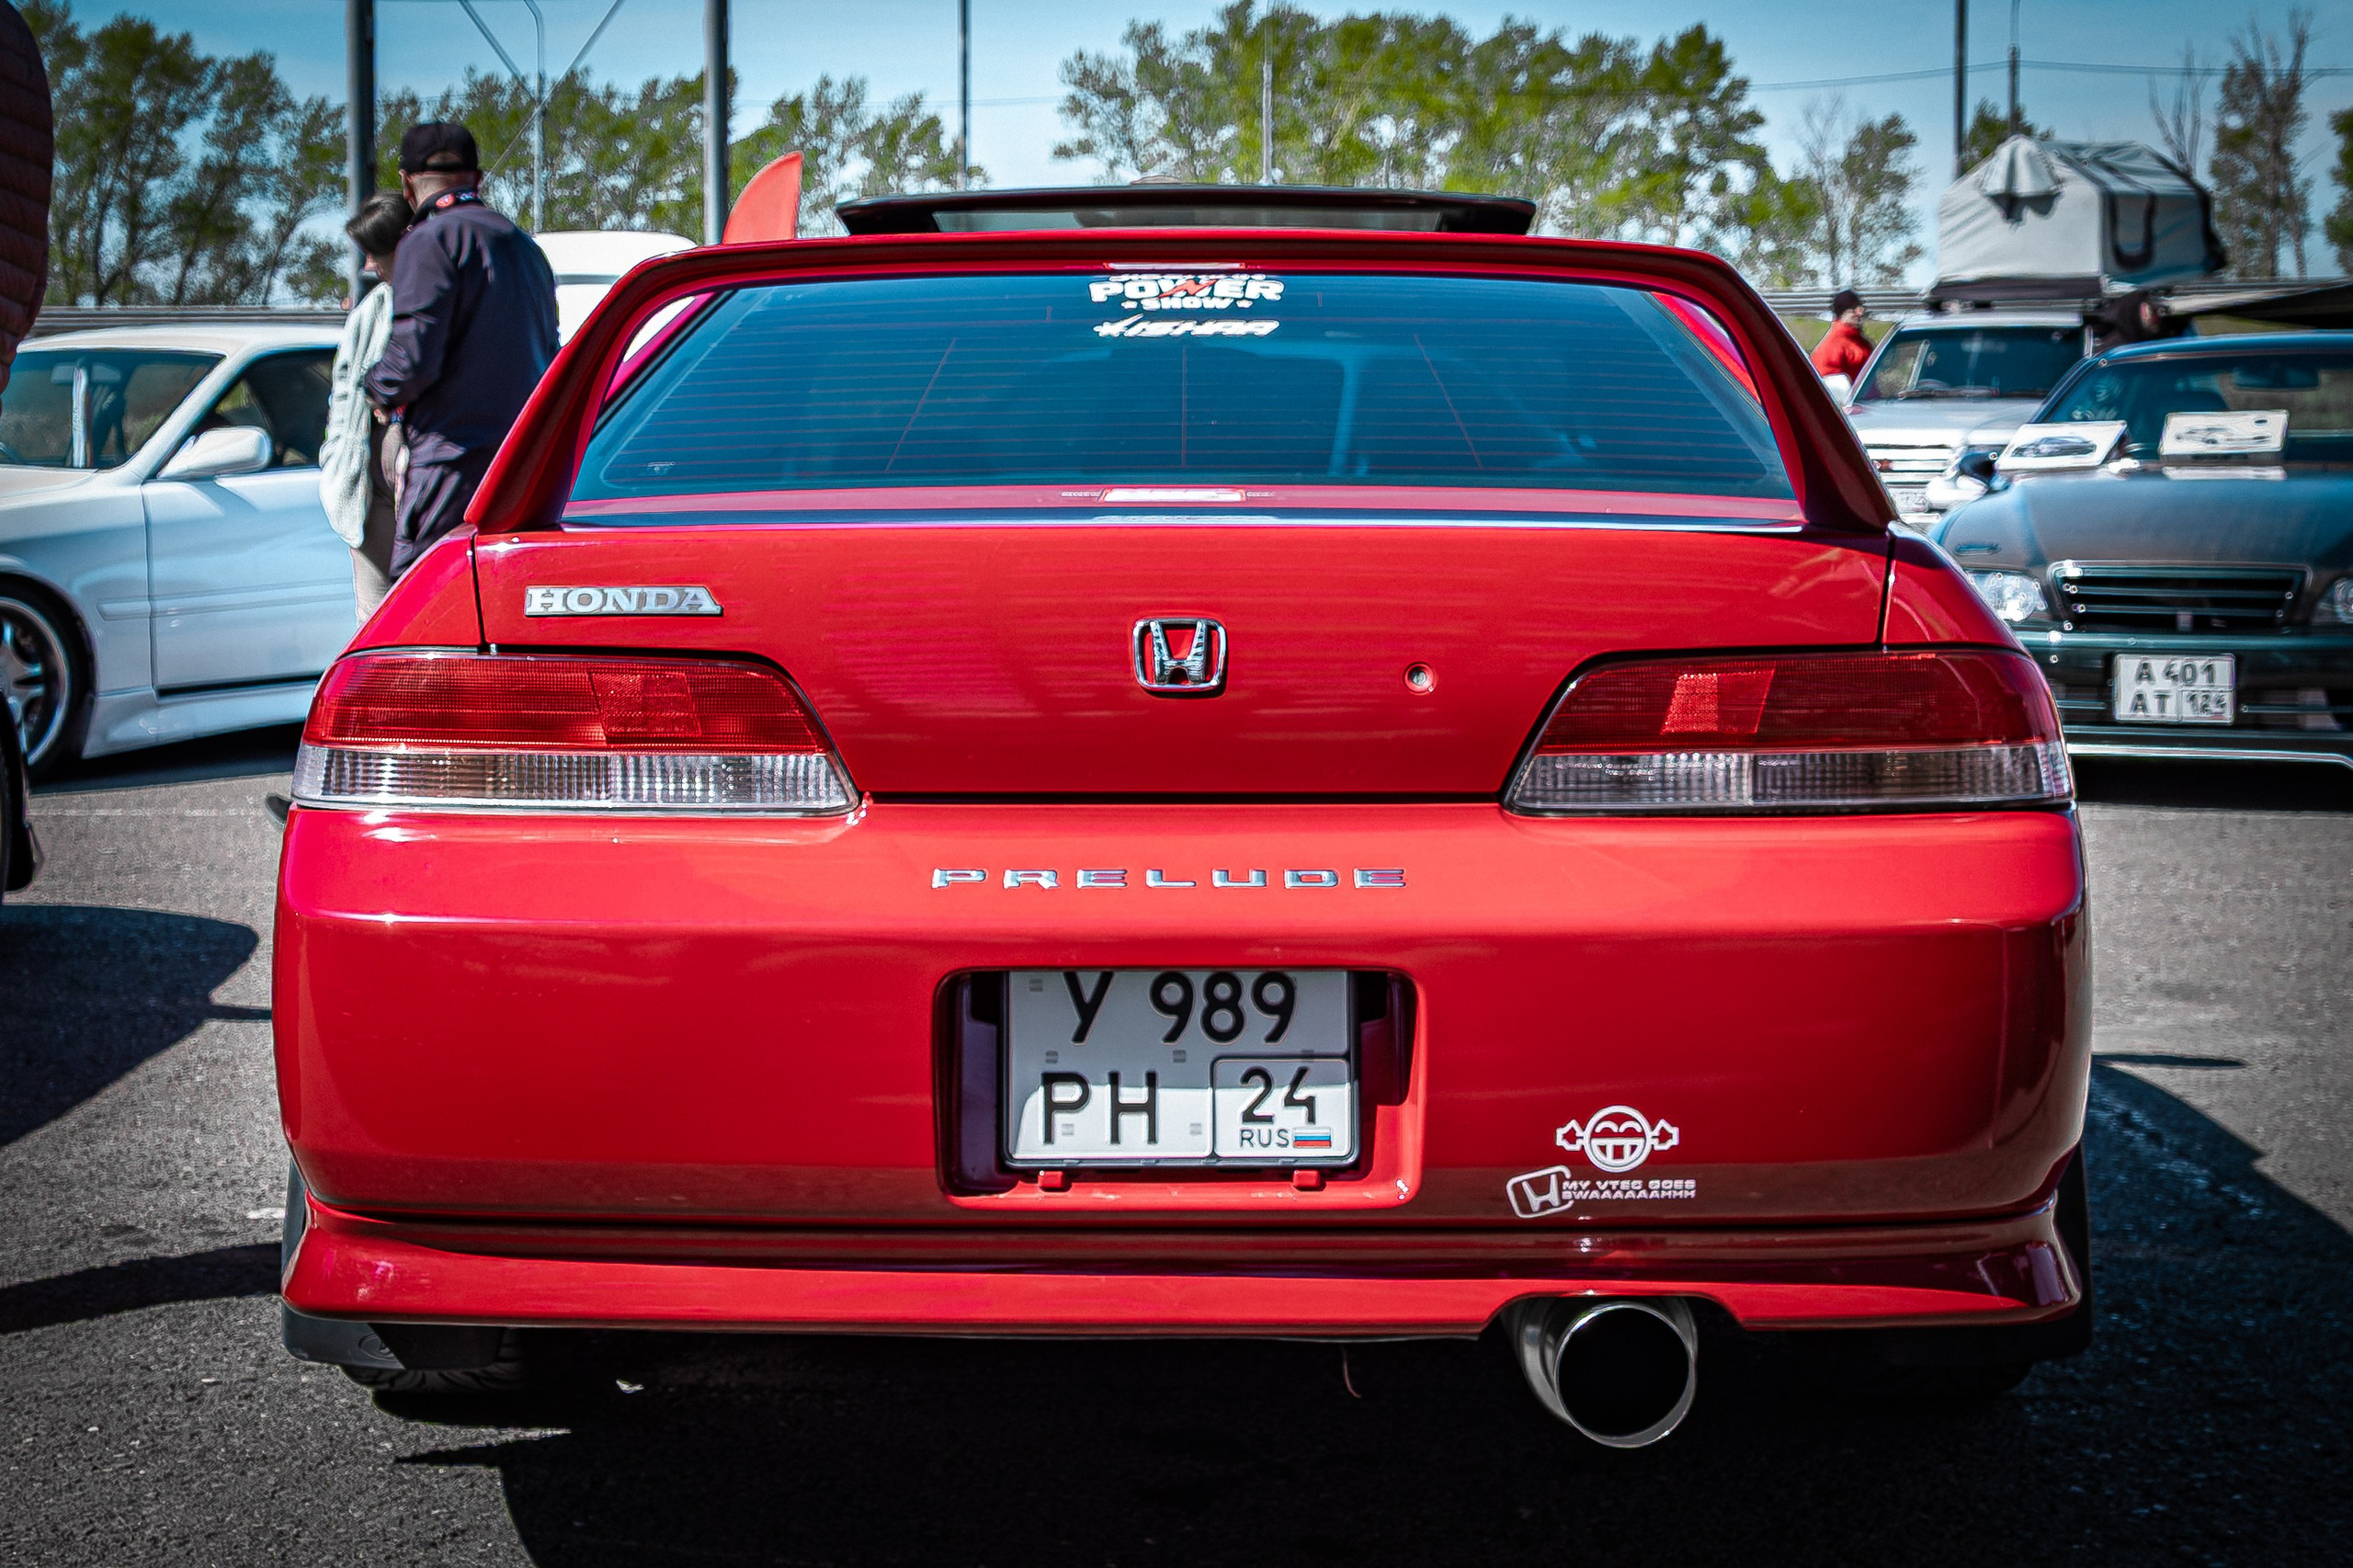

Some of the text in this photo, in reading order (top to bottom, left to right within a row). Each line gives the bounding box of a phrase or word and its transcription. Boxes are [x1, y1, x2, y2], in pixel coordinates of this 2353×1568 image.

[1089, 279, 1284, 301] POWER
[1141, 296, 1234, 311] SHOW
[528, 587, 720, 613] HONDA
[2164, 661, 2216, 686] 401
[932, 868, 1407, 889] PRELUDE
[1149, 971, 1298, 1045] 989
[1240, 1066, 1317, 1123] 24
[1239, 1129, 1289, 1148] RUS
[1563, 1179, 1696, 1190] MY VTEC GOES
